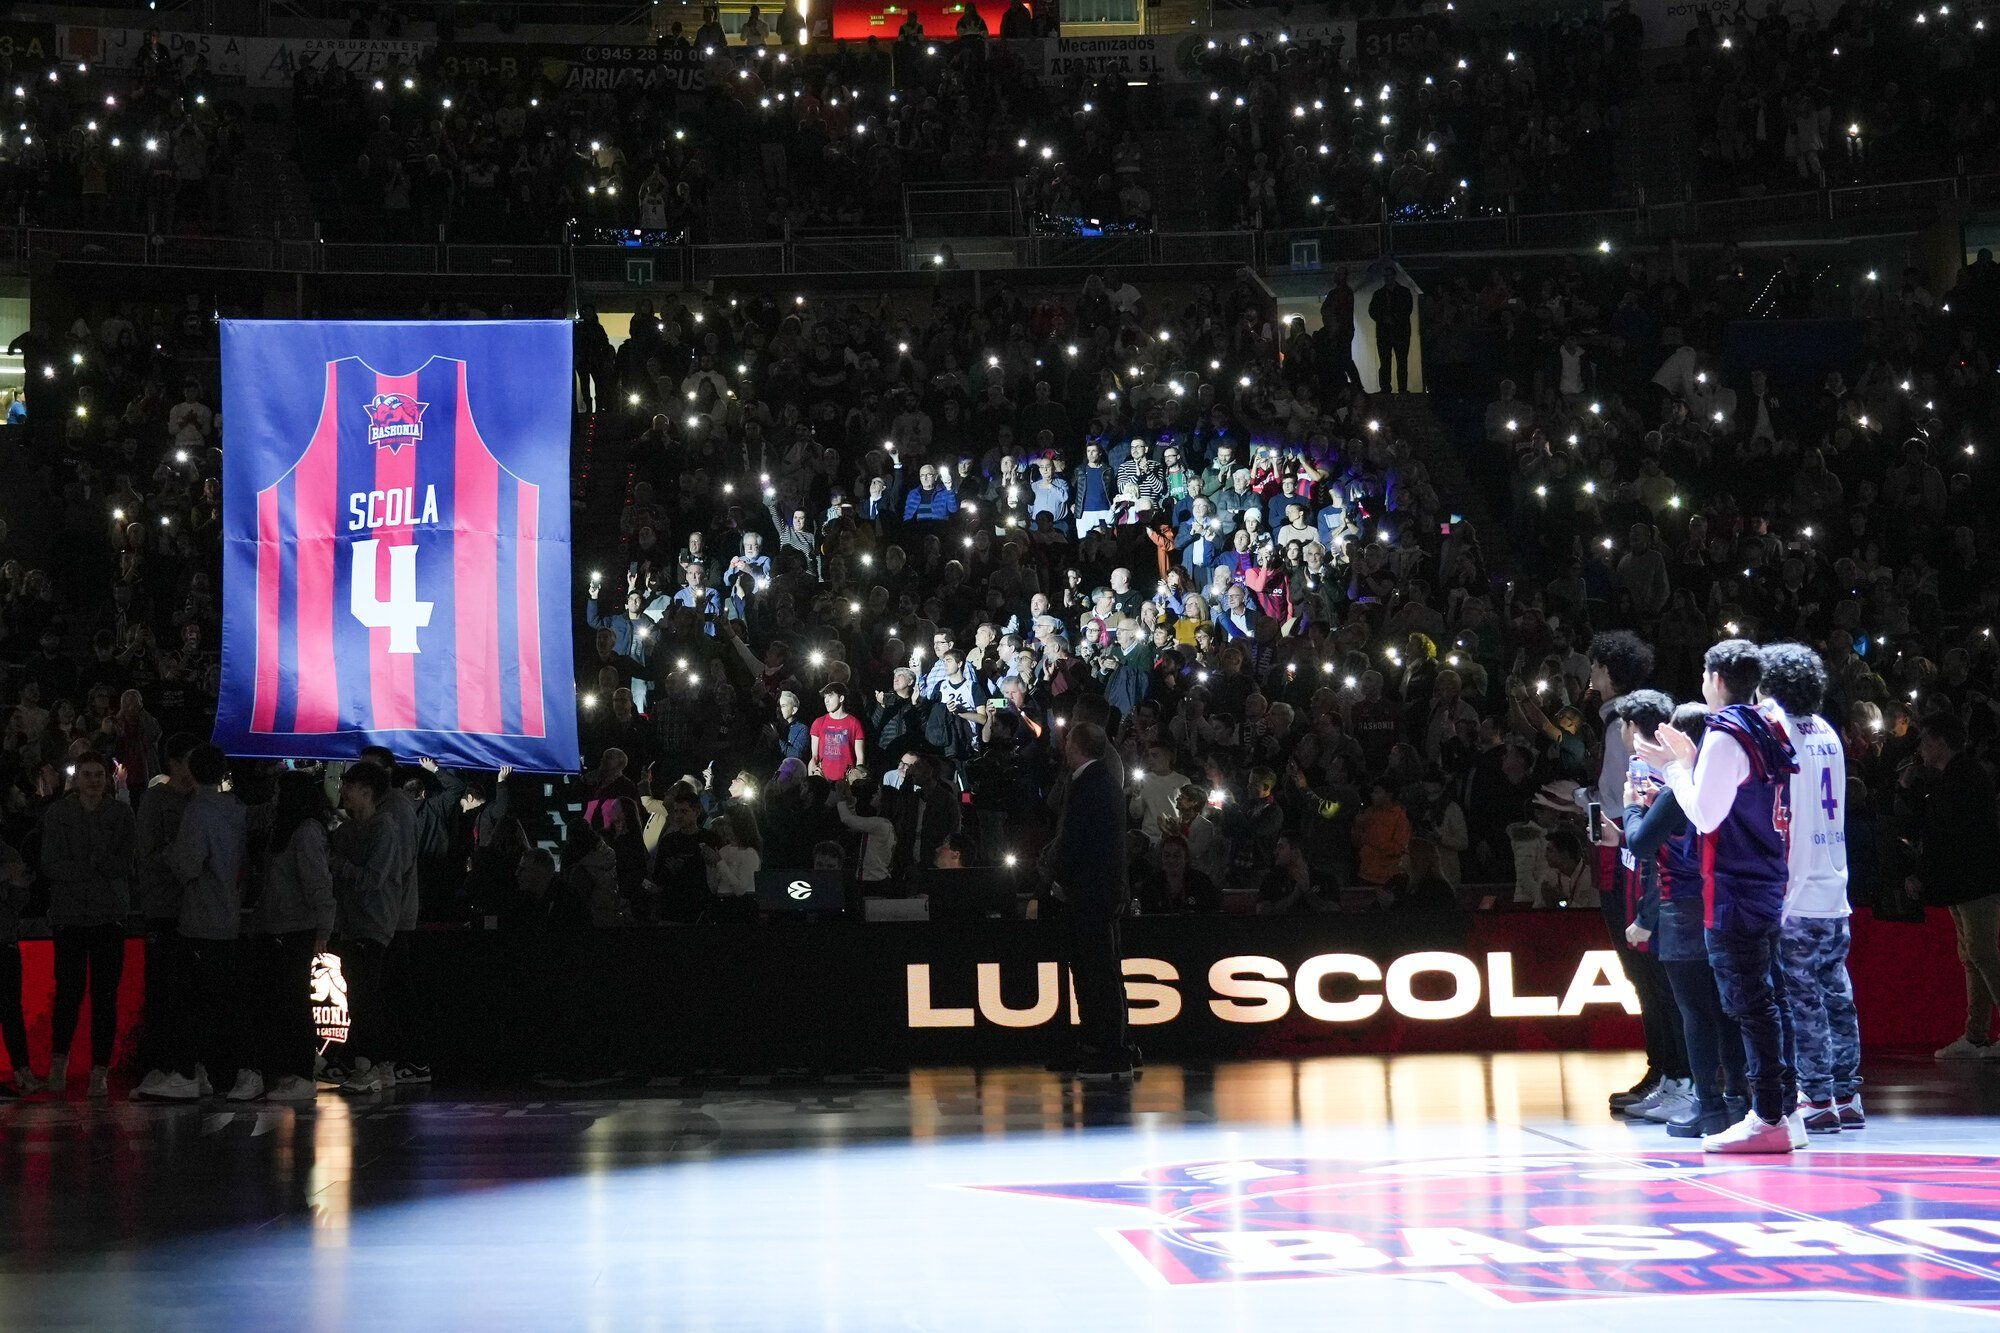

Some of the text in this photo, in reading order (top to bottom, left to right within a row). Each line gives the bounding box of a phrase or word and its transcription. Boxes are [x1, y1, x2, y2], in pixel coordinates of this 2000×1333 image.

[115, 30, 240, 55] JDSA
[305, 40, 419, 51] CARBURANTES
[1058, 37, 1155, 53] Mecanizados
[601, 47, 632, 60] 945
[637, 49, 657, 61] 28
[662, 49, 683, 61] 50
[372, 424, 419, 440] BASKONIA
[349, 484, 439, 531] SCOLA
[350, 538, 434, 653] 4
[948, 693, 963, 704] 24
[1821, 767, 1838, 820] 4
[1209, 950, 1643, 1025] SCOLA
